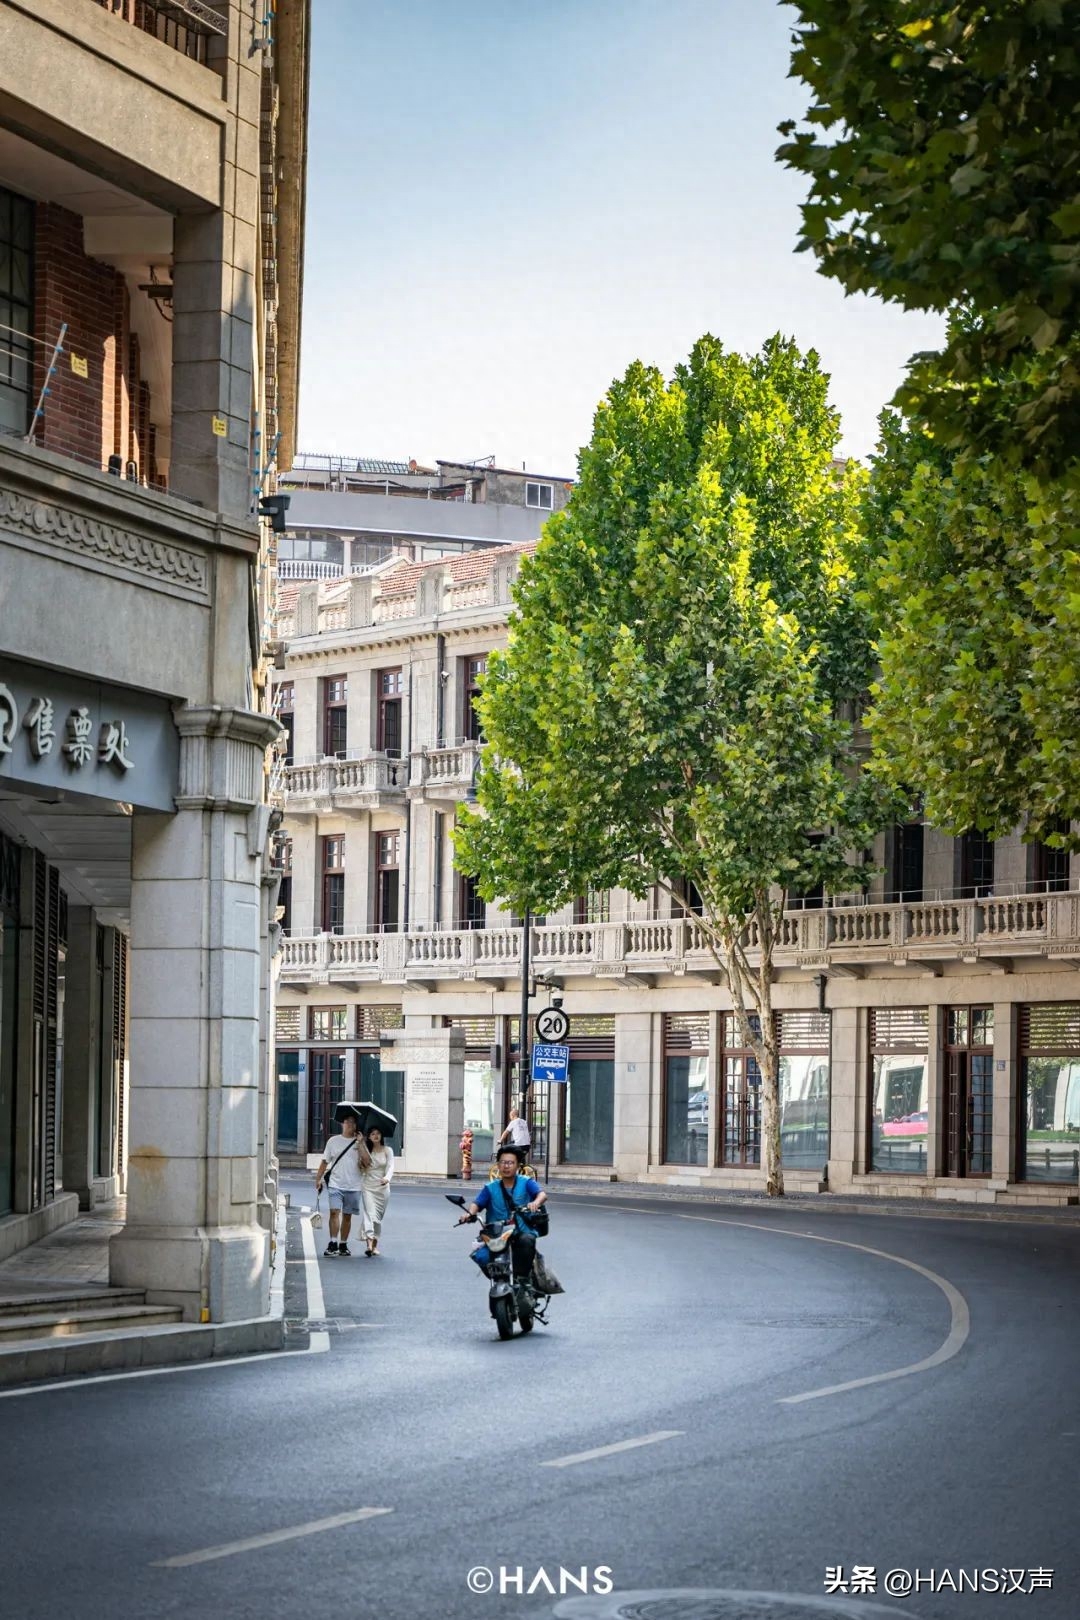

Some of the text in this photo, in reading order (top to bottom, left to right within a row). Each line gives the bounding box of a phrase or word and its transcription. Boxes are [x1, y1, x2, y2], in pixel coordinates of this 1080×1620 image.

[27, 697, 135, 769] 售票处
[543, 1017, 562, 1034] 20
[536, 1047, 567, 1058] 公交车站
